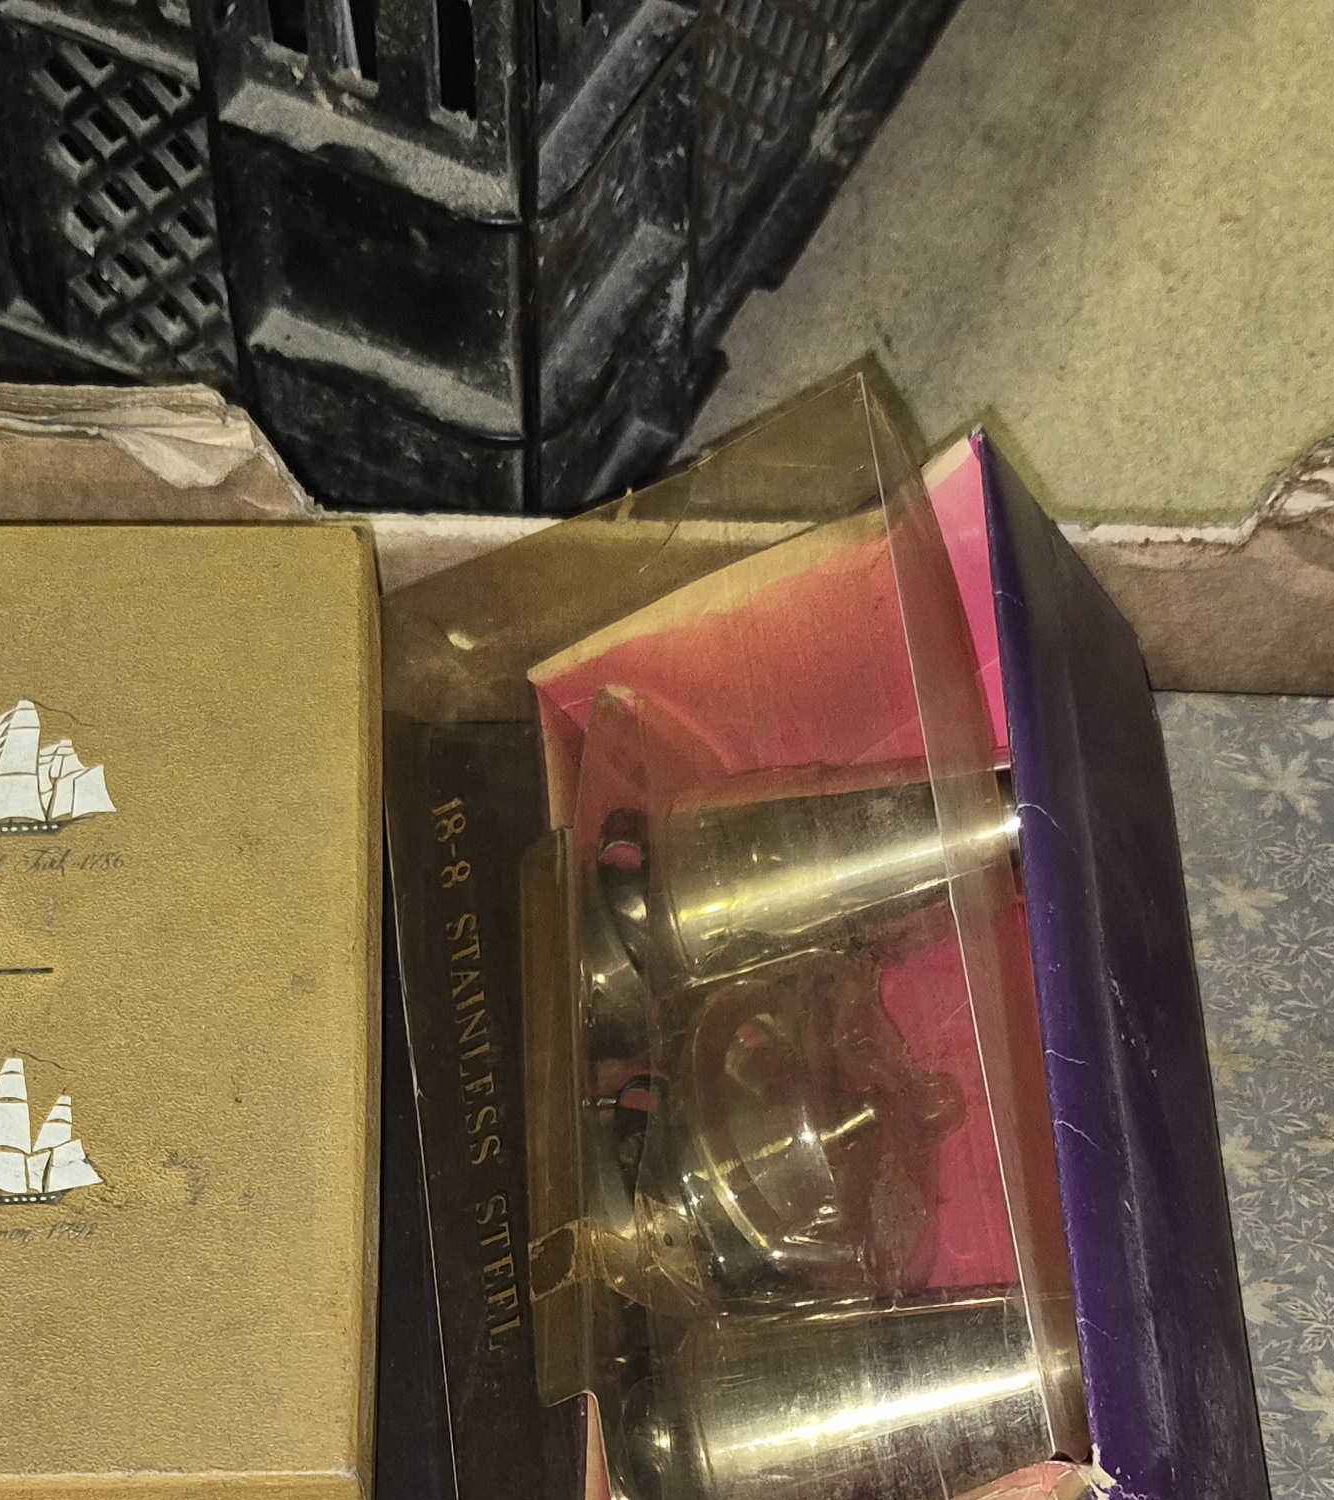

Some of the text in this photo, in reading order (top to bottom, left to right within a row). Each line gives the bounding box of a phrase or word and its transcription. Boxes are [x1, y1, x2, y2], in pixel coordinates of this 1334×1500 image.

[431, 798, 523, 1353] 18-8 STAINLESS STEEL
